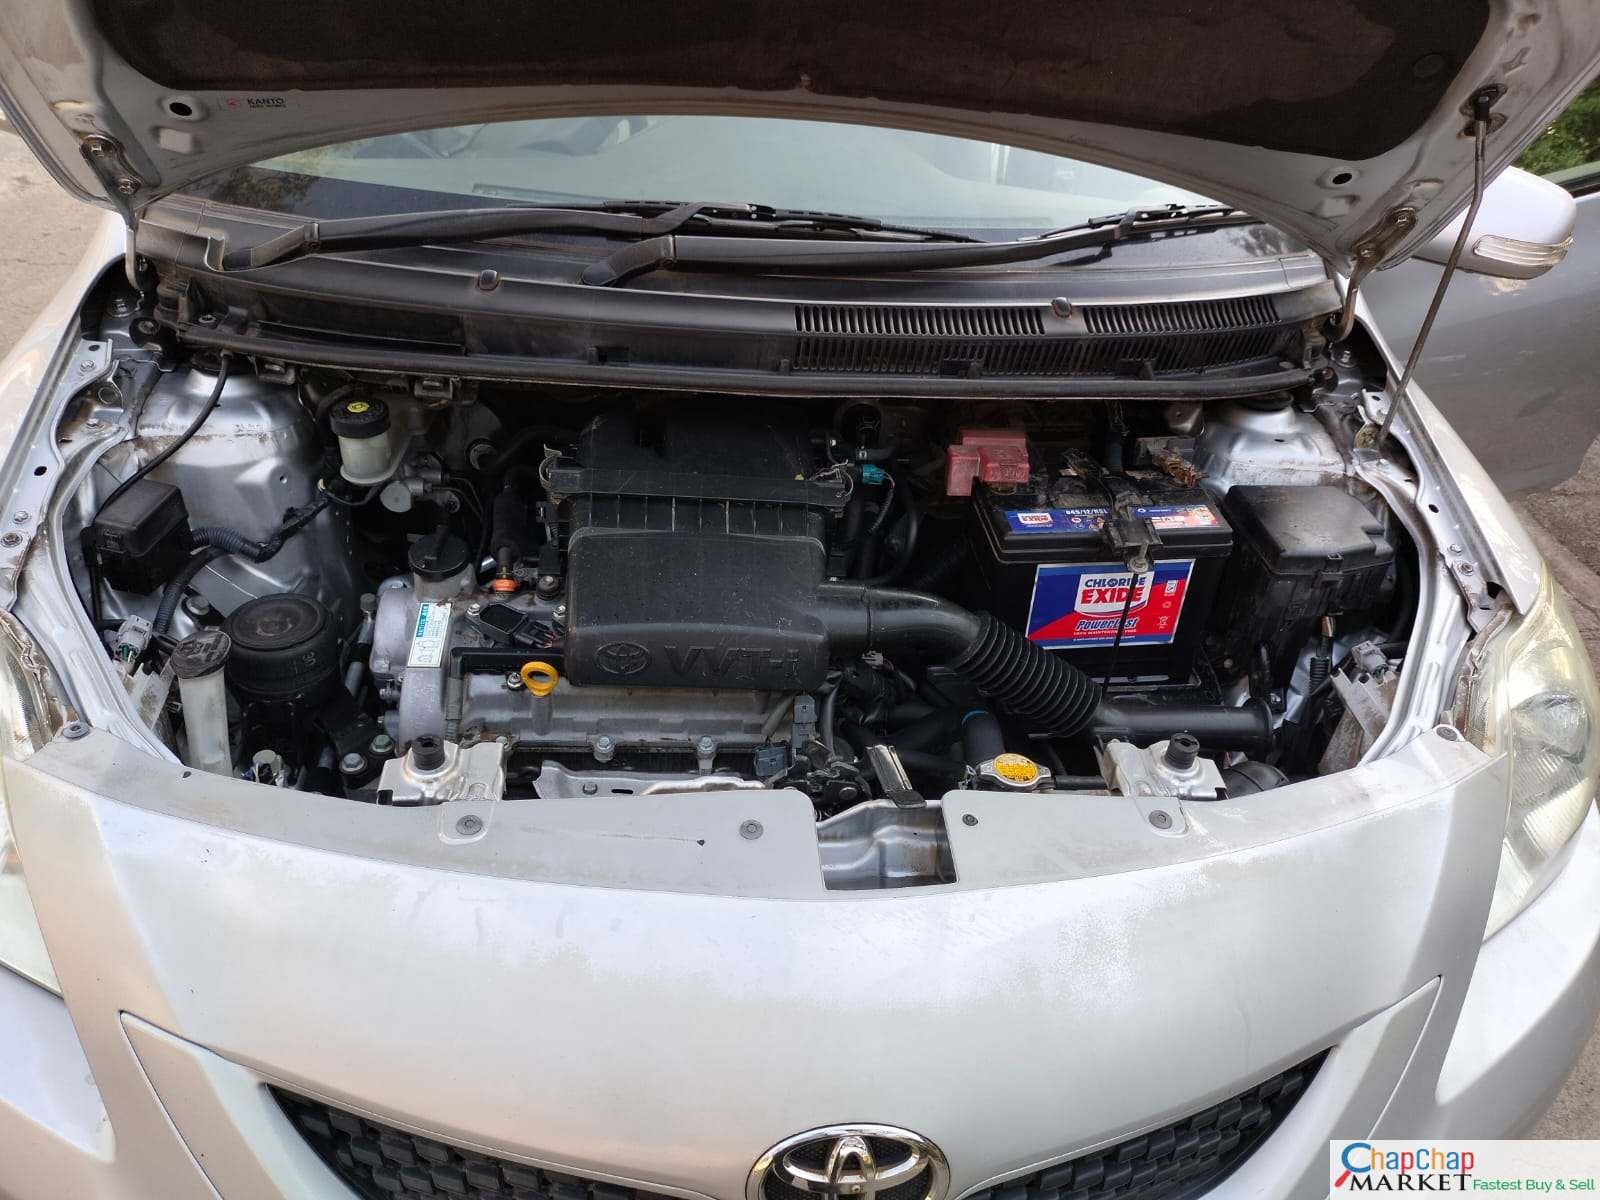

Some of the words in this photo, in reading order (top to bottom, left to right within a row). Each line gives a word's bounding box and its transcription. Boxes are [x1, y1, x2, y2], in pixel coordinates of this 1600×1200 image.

[1084, 576, 1146, 588] CHLORIE
[1081, 587, 1145, 604] EXIDE
[1076, 617, 1139, 631] PowerLst
